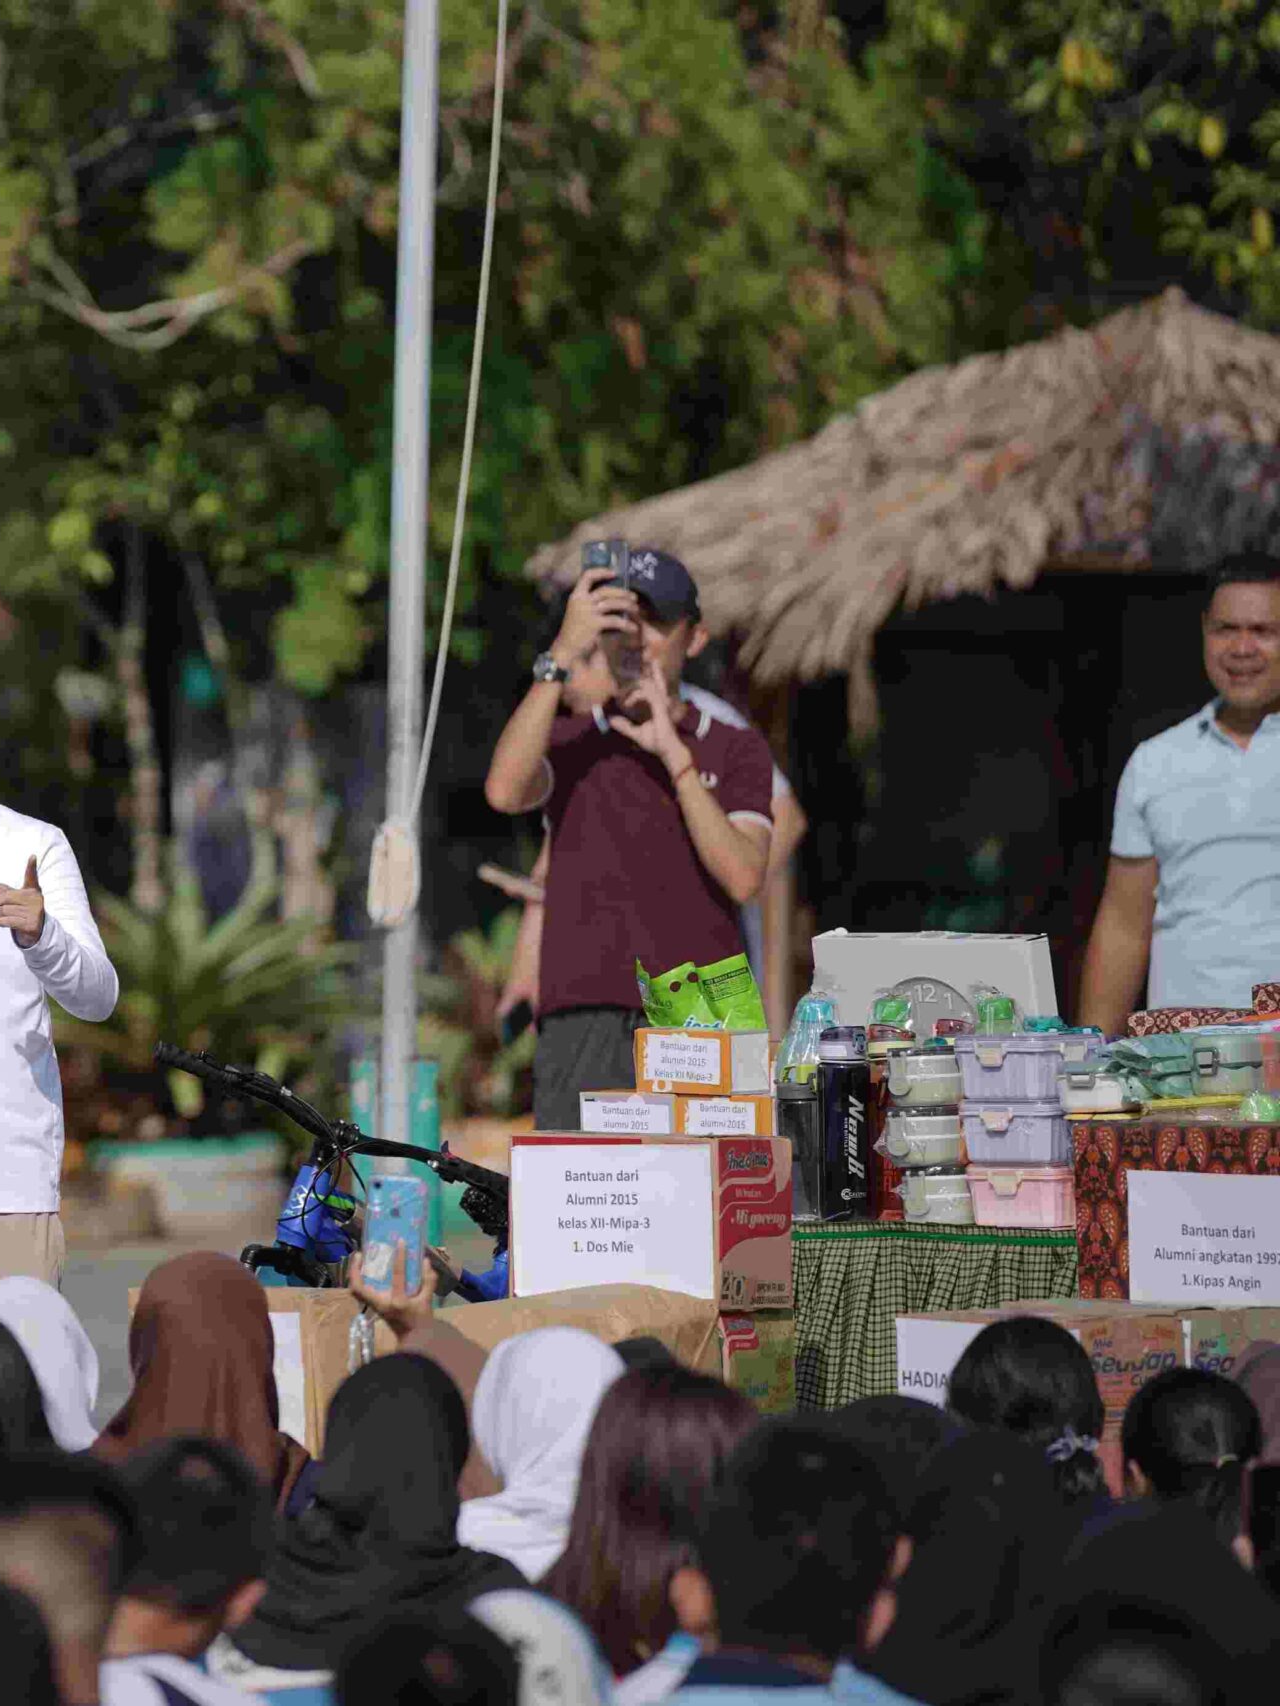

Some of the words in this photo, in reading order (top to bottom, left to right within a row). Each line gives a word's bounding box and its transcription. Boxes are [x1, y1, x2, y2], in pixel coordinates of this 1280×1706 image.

[914, 983, 937, 1003] 12
[943, 993, 953, 1010] 1
[687, 1056, 707, 1067] 2015
[602, 1105, 634, 1116] Bantuan
[635, 1106, 650, 1117] dari
[699, 1103, 730, 1114] Bantuan
[731, 1103, 747, 1114] dari
[630, 1120, 649, 1131] 2015
[727, 1118, 746, 1130] 2015
[565, 1169, 613, 1183] Bantuan
[616, 1169, 639, 1183] dari
[566, 1193, 608, 1206] Alumni
[610, 1193, 639, 1206] 2015
[558, 1216, 587, 1229] kelas
[590, 1216, 651, 1232] XII-Mipa-3
[1181, 1223, 1229, 1238] Bantuan
[1231, 1225, 1256, 1239] dari
[573, 1241, 584, 1253] 1.
[586, 1241, 608, 1253] Dos
[611, 1241, 634, 1253] Mie
[1153, 1247, 1196, 1261] Alumni
[1199, 1249, 1253, 1265] angkatan
[1227, 1275, 1261, 1291] Angin
